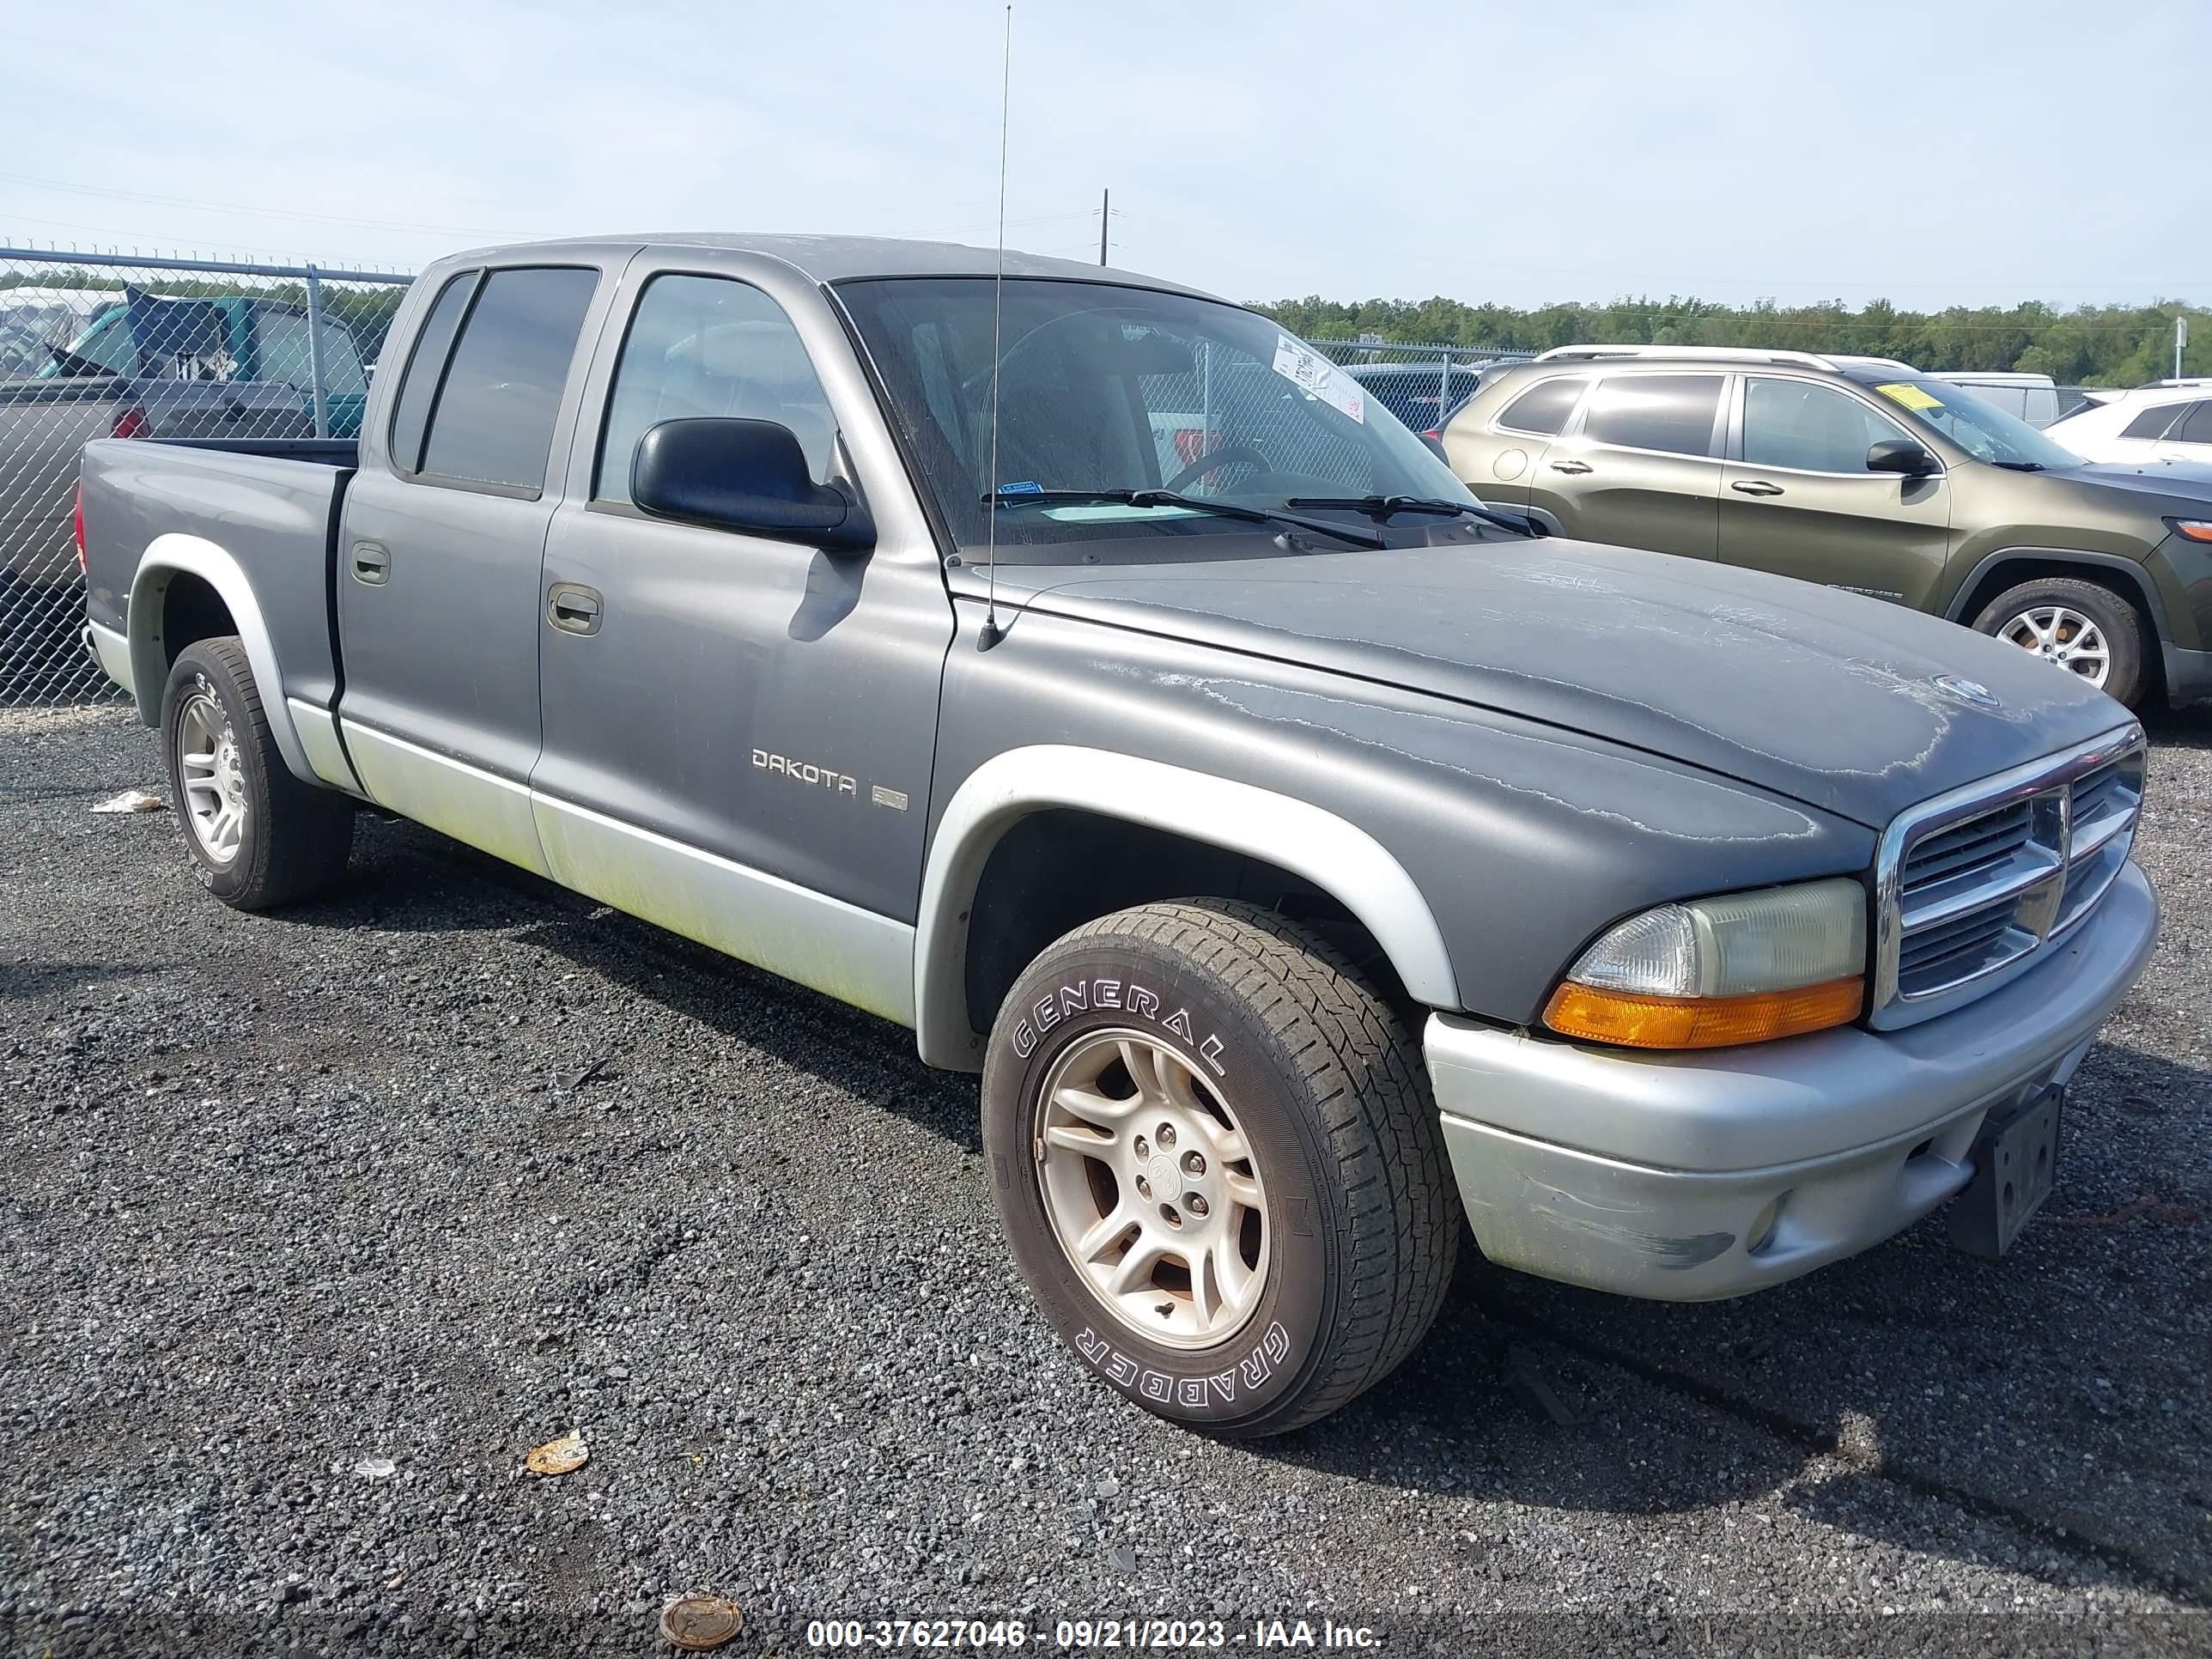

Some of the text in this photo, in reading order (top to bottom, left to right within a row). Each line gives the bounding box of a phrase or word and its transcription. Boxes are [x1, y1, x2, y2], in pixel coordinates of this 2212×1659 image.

[752, 748, 857, 796] DAKOTA
[1013, 979, 1226, 1077] GENERAL
[1075, 1322, 1290, 1407] GRABBER
